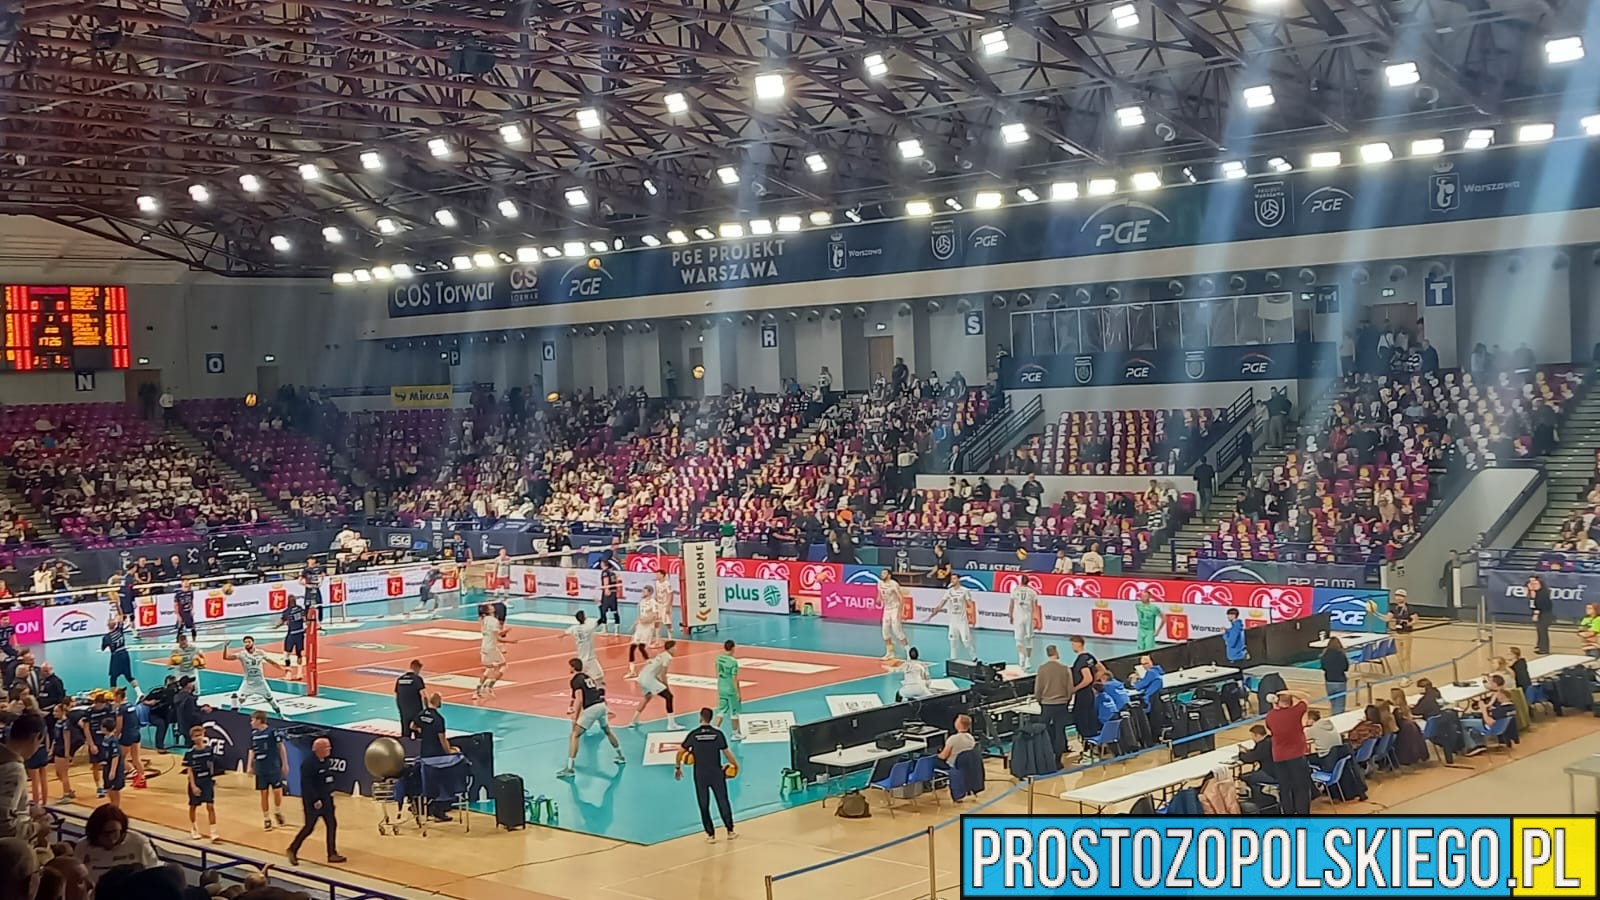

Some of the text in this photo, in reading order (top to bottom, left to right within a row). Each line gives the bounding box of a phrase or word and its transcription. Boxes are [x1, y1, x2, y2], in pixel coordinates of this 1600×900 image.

[1464, 181, 1520, 193] Warszawa
[1311, 198, 1343, 213] PGE
[1096, 219, 1151, 247] PGE
[974, 235, 998, 248] PGE
[672, 239, 785, 267] PGE PROJEKT
[681, 260, 778, 285] WARSZAWA
[395, 280, 494, 308] COS Torwar
[569, 277, 602, 297] PGE
[1430, 282, 1447, 304] T
[967, 313, 980, 334] S
[762, 330, 775, 347] R
[451, 352, 459, 365] P
[1126, 367, 1150, 378] PGE
[1241, 362, 1268, 374] PGE
[78, 375, 94, 391] N
[1021, 372, 1042, 383] PGE
[696, 545, 707, 608] KRISHOME
[724, 583, 759, 603] plus
[1330, 610, 1365, 625] PGE
[61, 620, 88, 633] PGE
